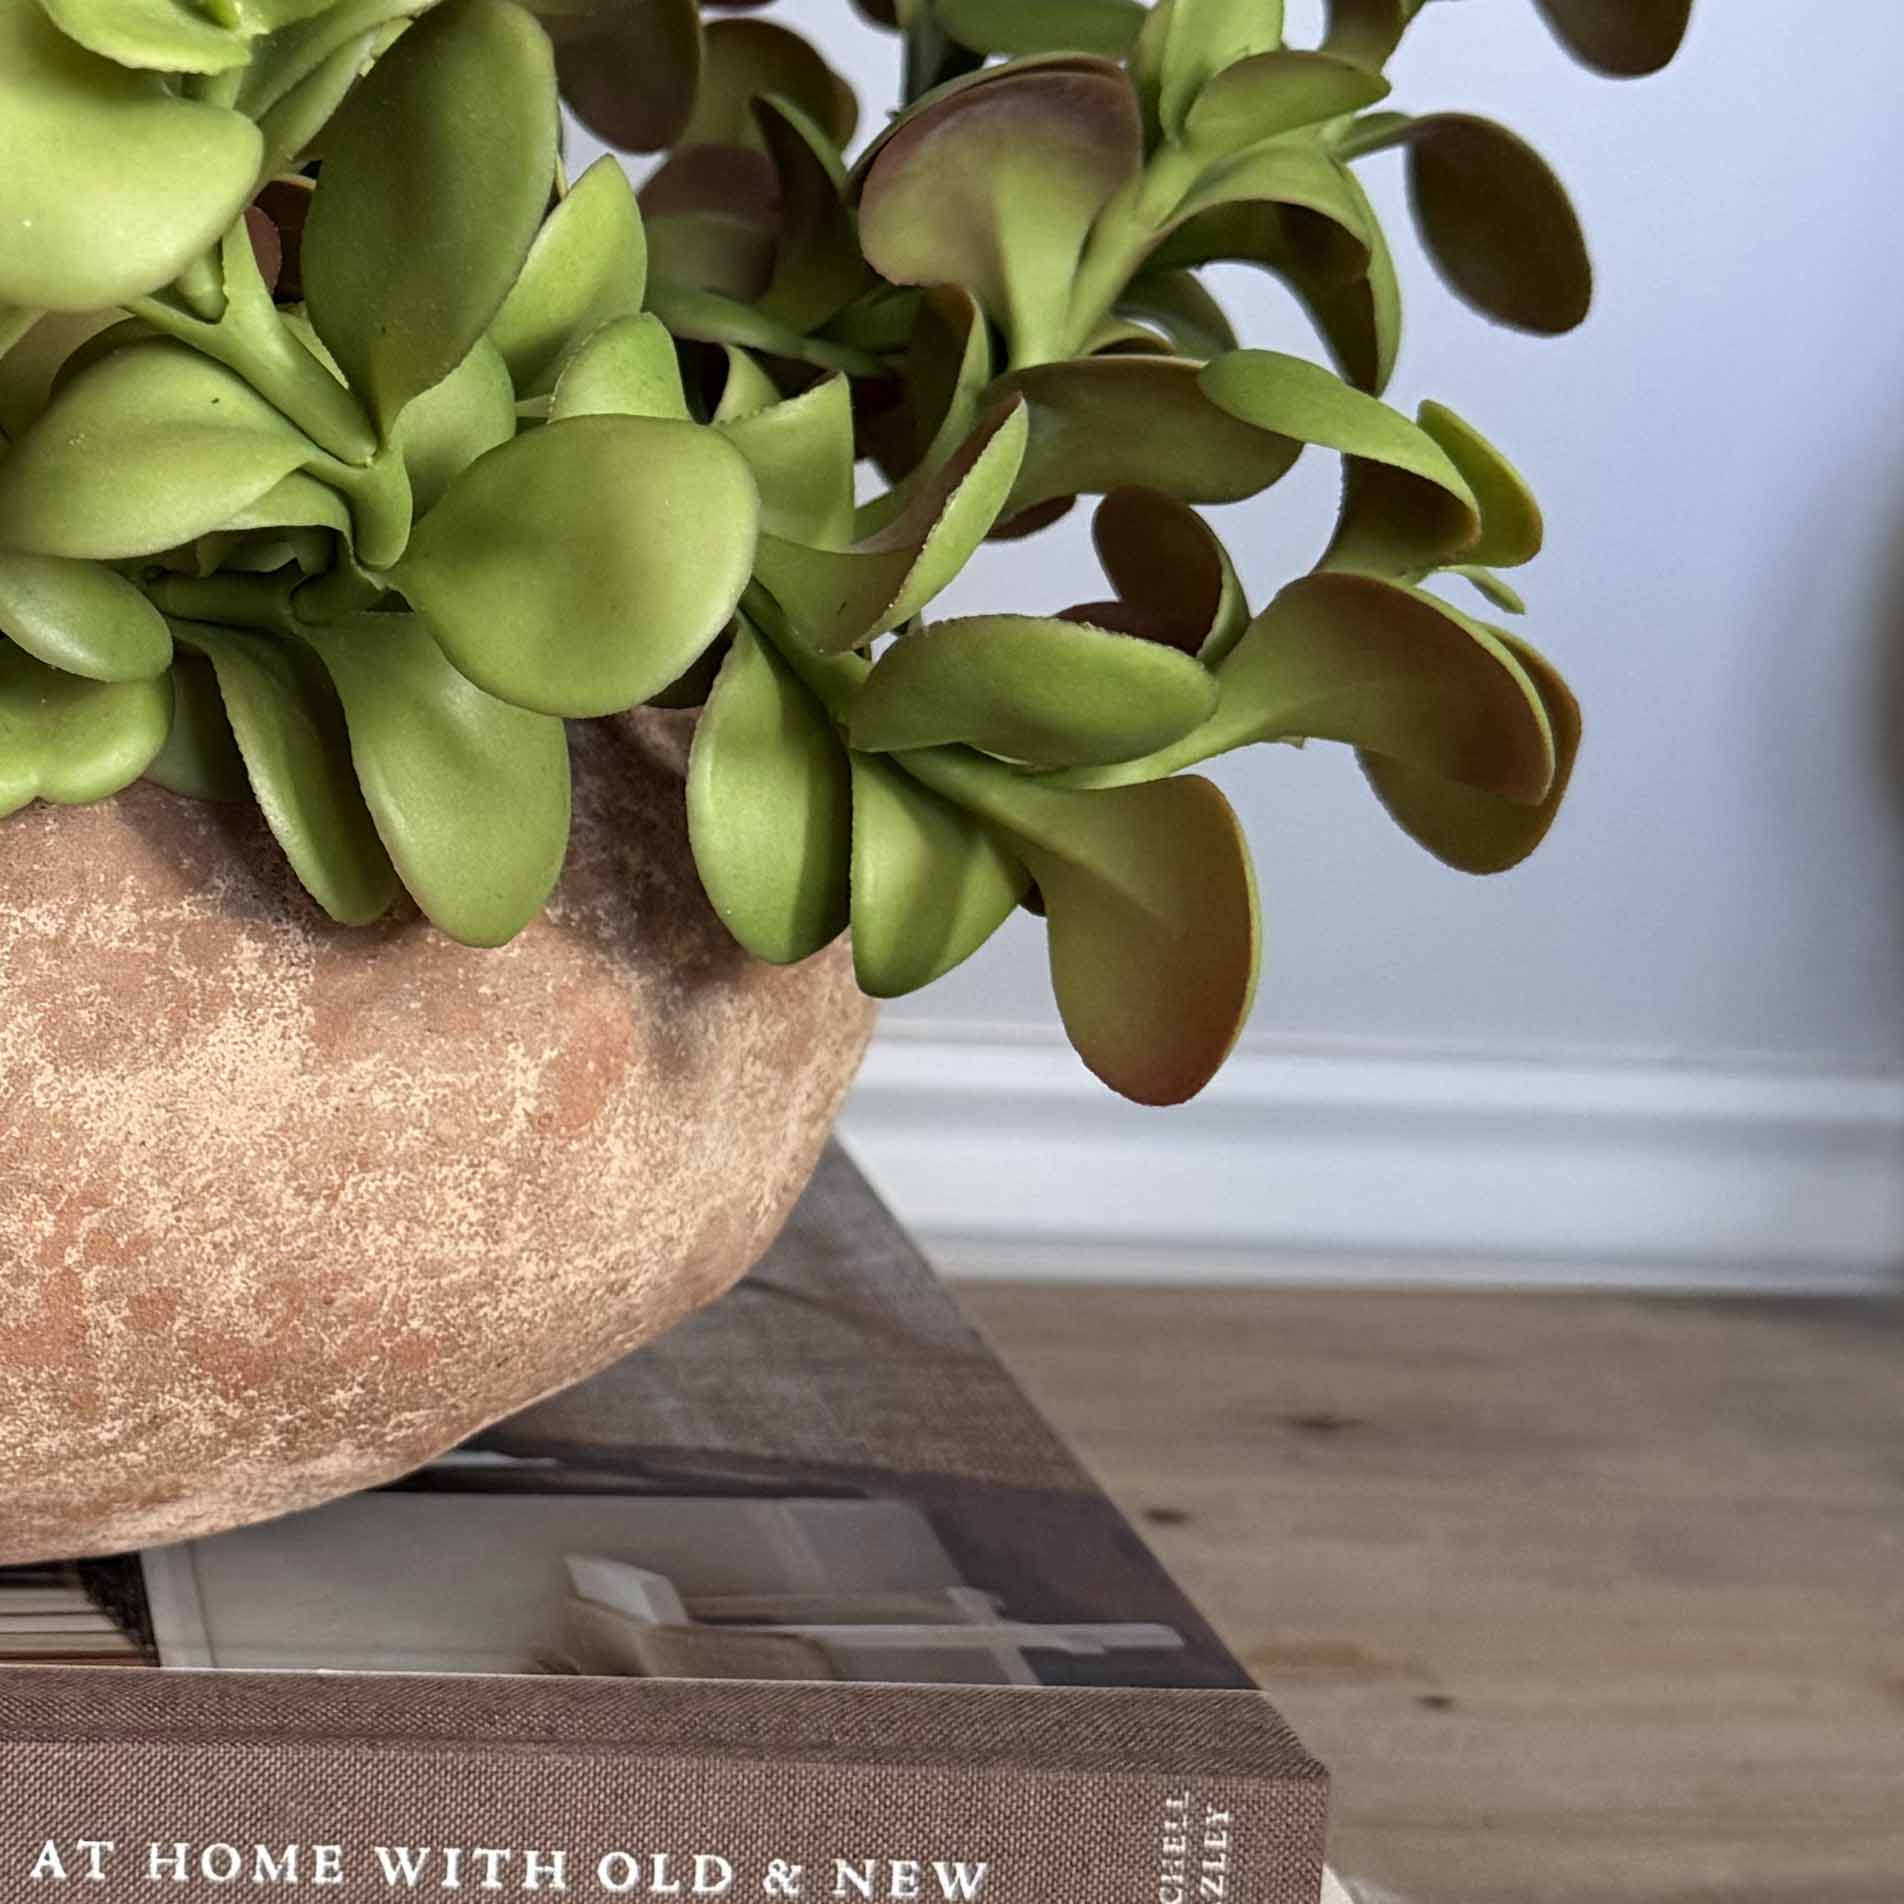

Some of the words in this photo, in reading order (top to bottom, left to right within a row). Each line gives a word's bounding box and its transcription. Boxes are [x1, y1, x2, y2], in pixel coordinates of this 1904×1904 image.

[29, 1839, 114, 1882] AT
[148, 1840, 344, 1888] HOME
[373, 1846, 568, 1893] WITH
[596, 1852, 736, 1894] OLD
[762, 1857, 803, 1896] &
[834, 1858, 992, 1900] NEW
